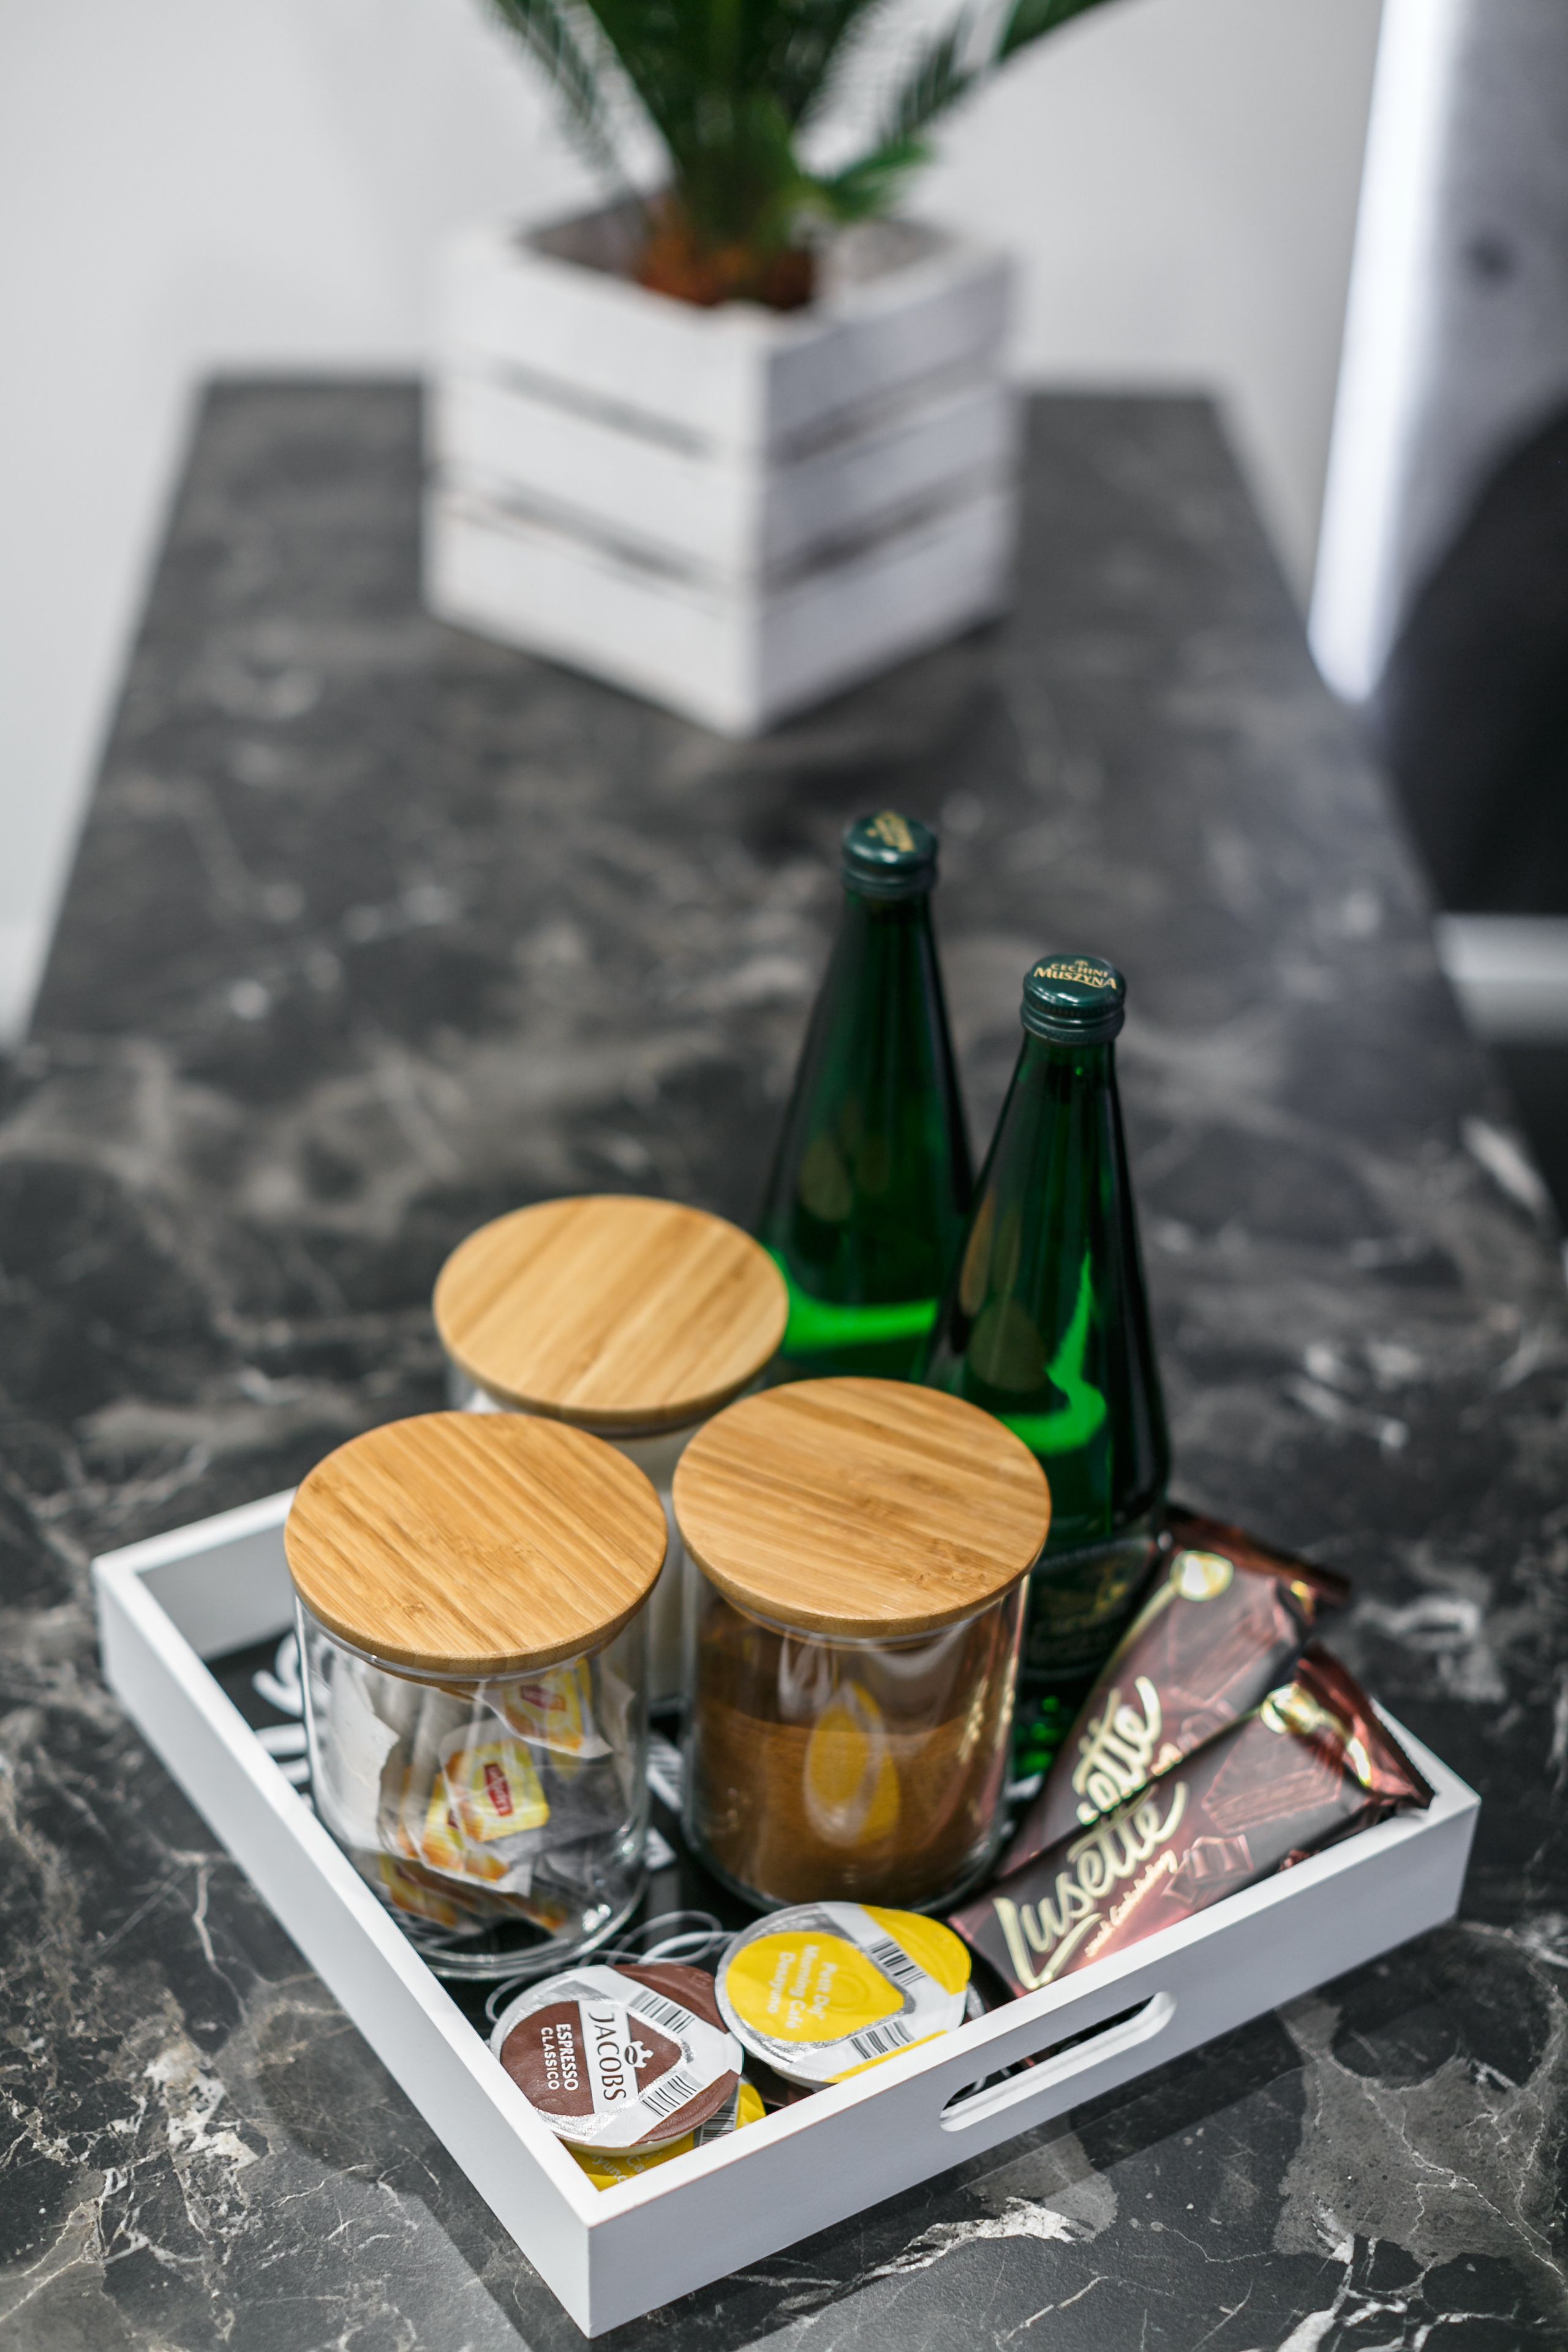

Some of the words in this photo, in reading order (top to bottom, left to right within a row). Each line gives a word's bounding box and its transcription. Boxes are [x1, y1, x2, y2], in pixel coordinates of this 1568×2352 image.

[1050, 963, 1108, 978] CECHINI
[993, 1782, 1188, 1990] Lusette
[541, 2027, 560, 2090] CLASSICO
[556, 2023, 579, 2091] ESPRESSO
[588, 2012, 627, 2100] JACOBS
